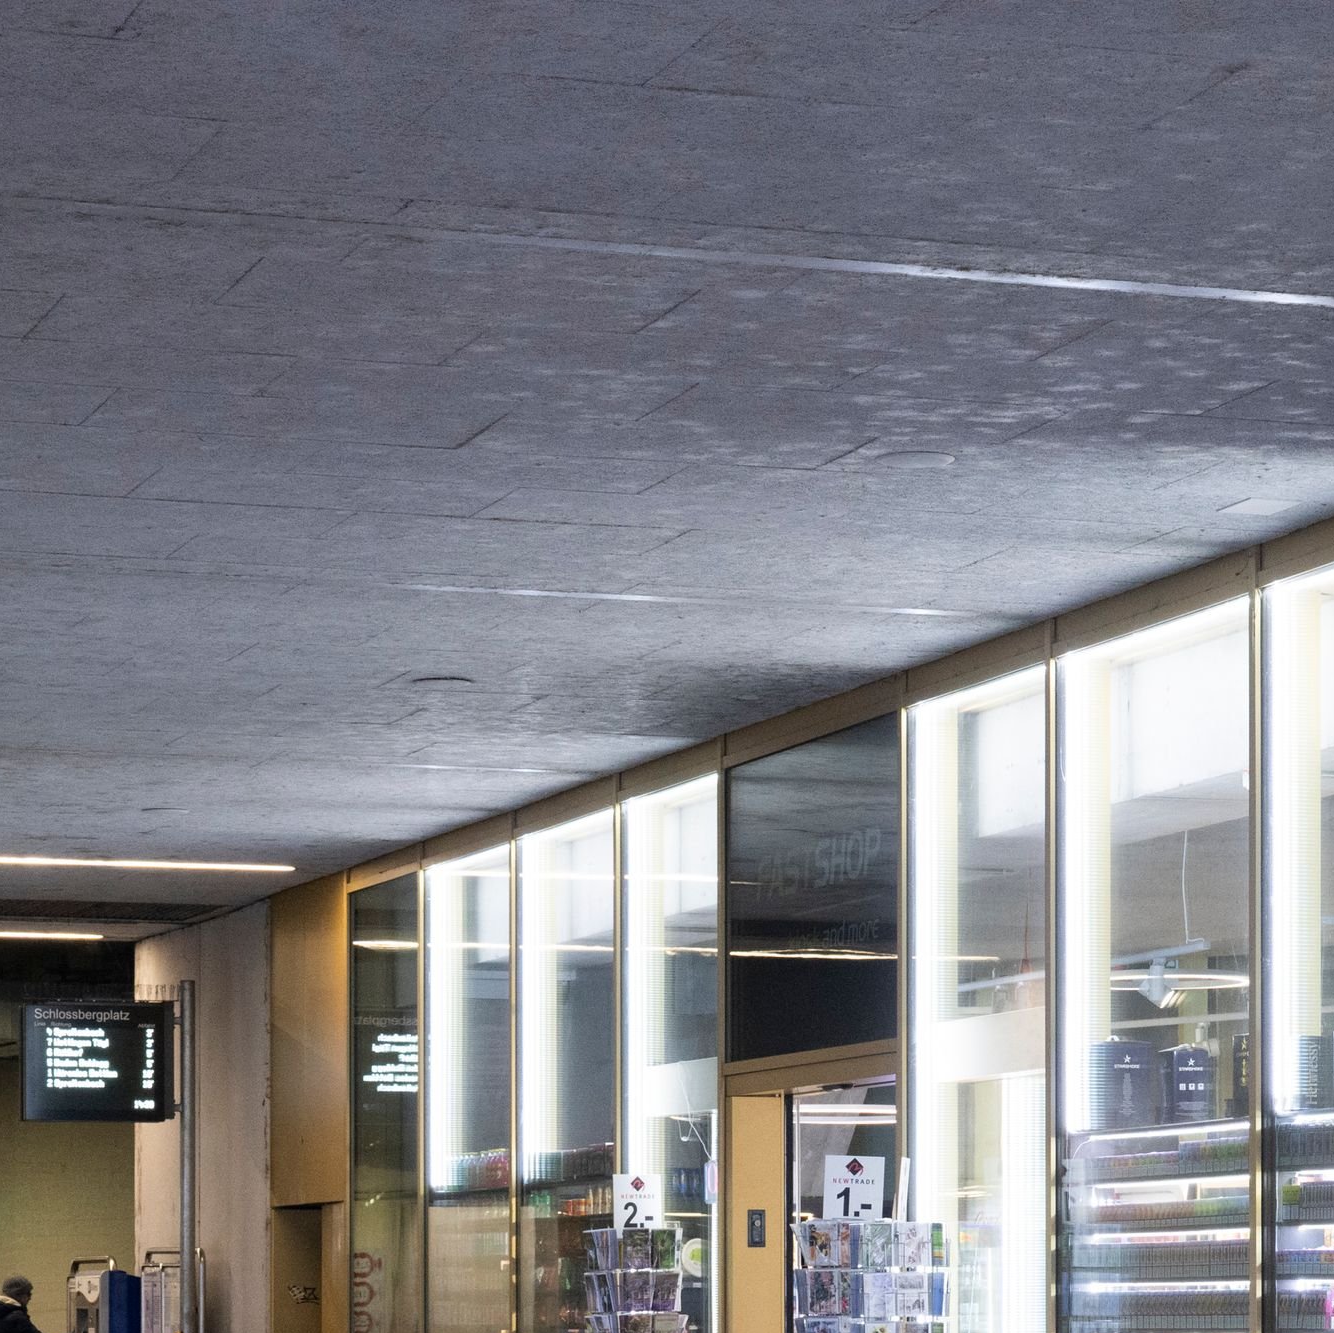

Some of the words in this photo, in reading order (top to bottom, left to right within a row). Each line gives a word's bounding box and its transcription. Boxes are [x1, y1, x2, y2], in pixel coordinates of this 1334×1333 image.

[34, 1008, 130, 1022] Schlossbergplatz
[624, 1202, 654, 1228] 2.-
[836, 1187, 872, 1217] 1.-
